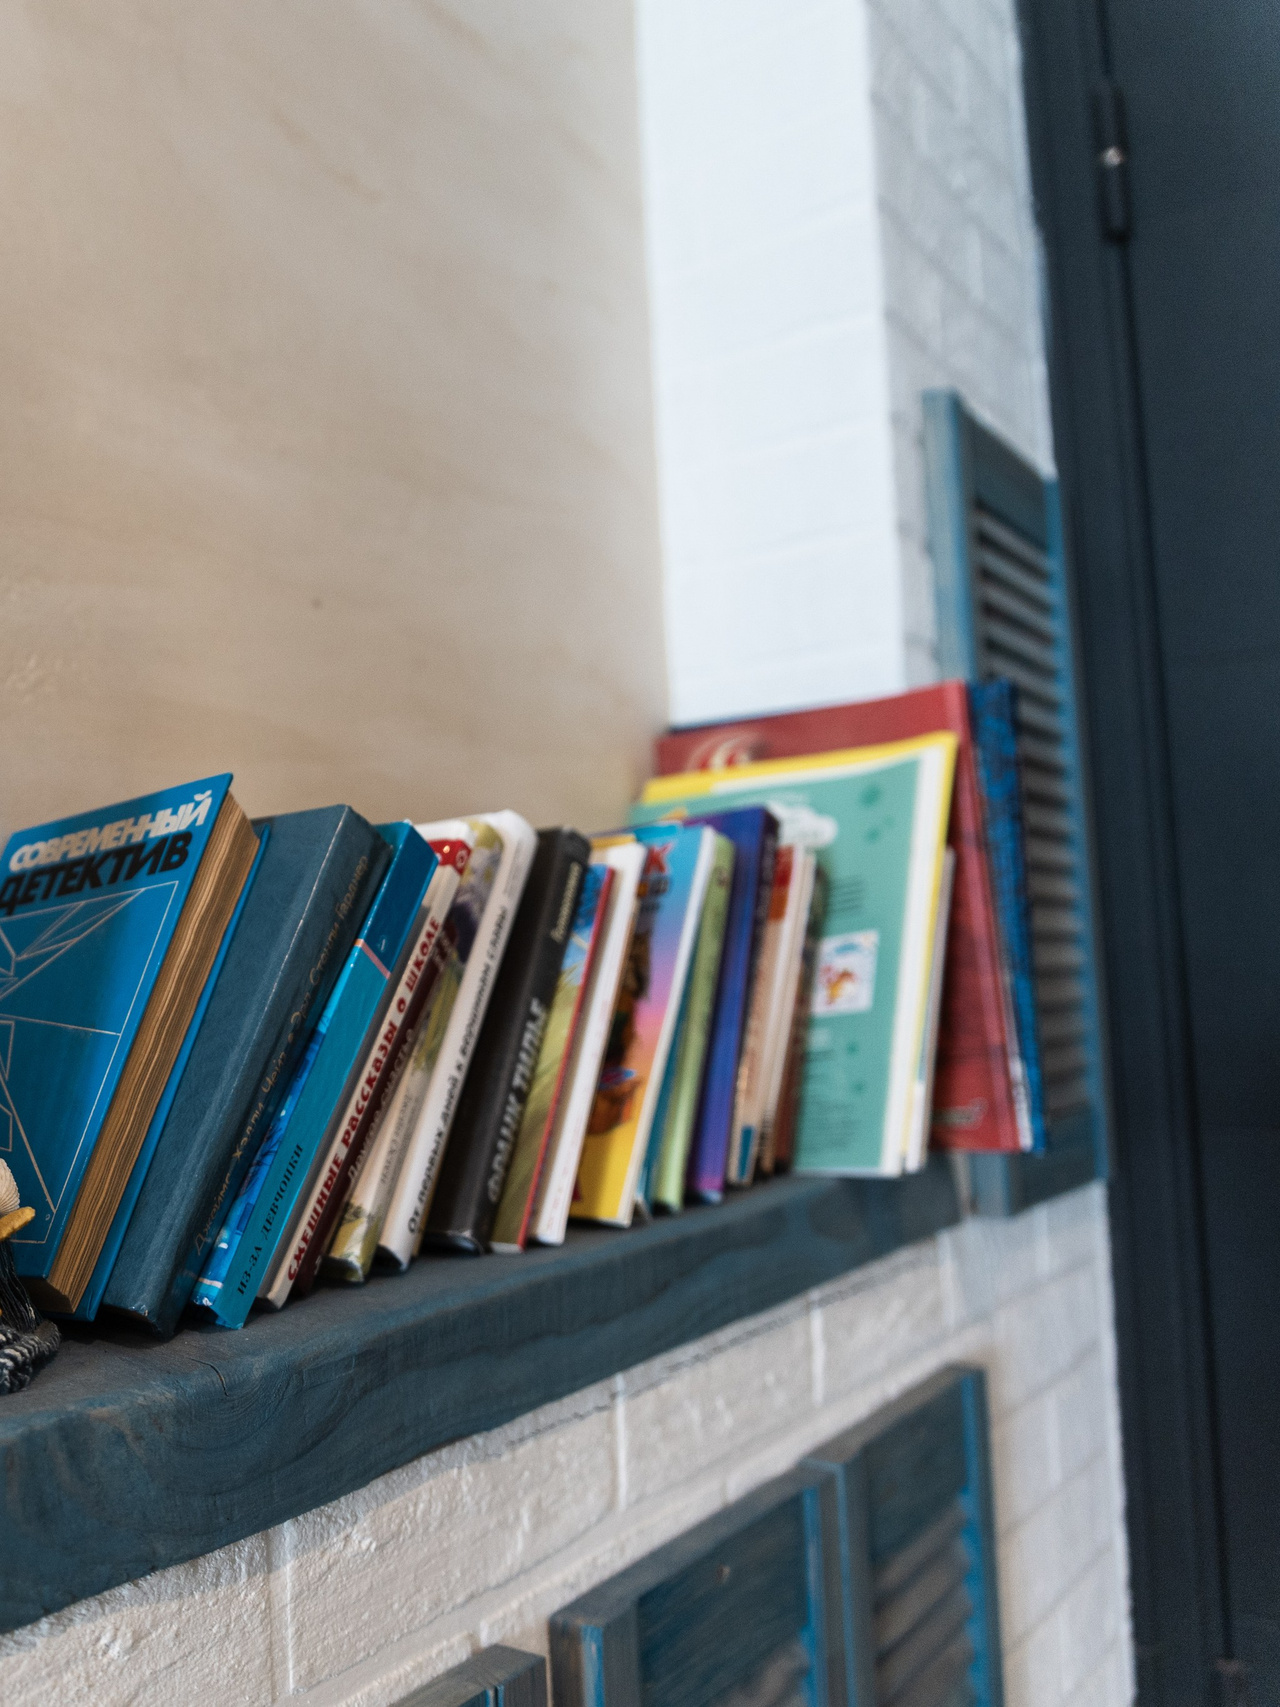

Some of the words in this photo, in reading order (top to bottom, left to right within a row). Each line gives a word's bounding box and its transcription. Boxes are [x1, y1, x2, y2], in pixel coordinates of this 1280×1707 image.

[10, 790, 212, 873] СОВРЕМЕННЫЙ
[335, 855, 368, 920] Гарднер
[287, 1155, 343, 1282] СМЕШНЫЕ
[405, 916, 441, 994] ШКОЛЕ
[237, 1245, 263, 1296] ИЗ-ЗА
[260, 1143, 304, 1241] ДЕВЧОНКИ
